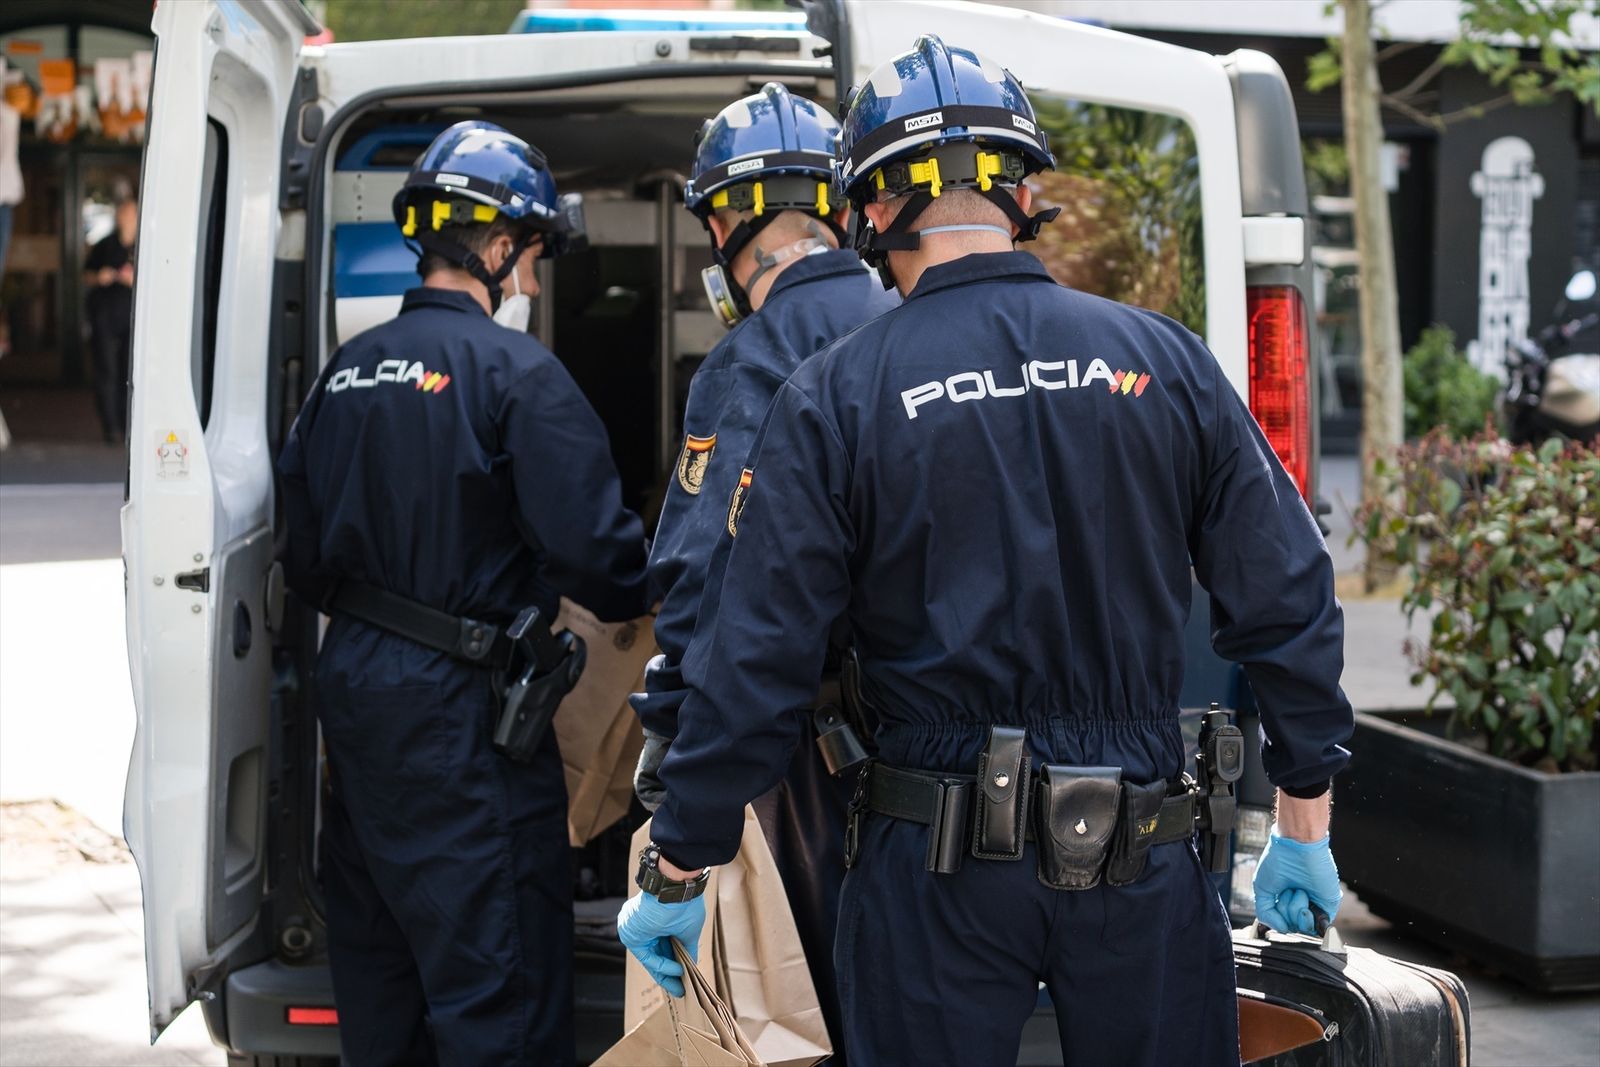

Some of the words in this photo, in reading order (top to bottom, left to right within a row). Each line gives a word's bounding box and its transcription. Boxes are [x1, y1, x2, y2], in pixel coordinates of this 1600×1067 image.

[907, 115, 940, 129] MSA
[729, 160, 761, 173] MSA
[900, 357, 1119, 420] POLICIA
